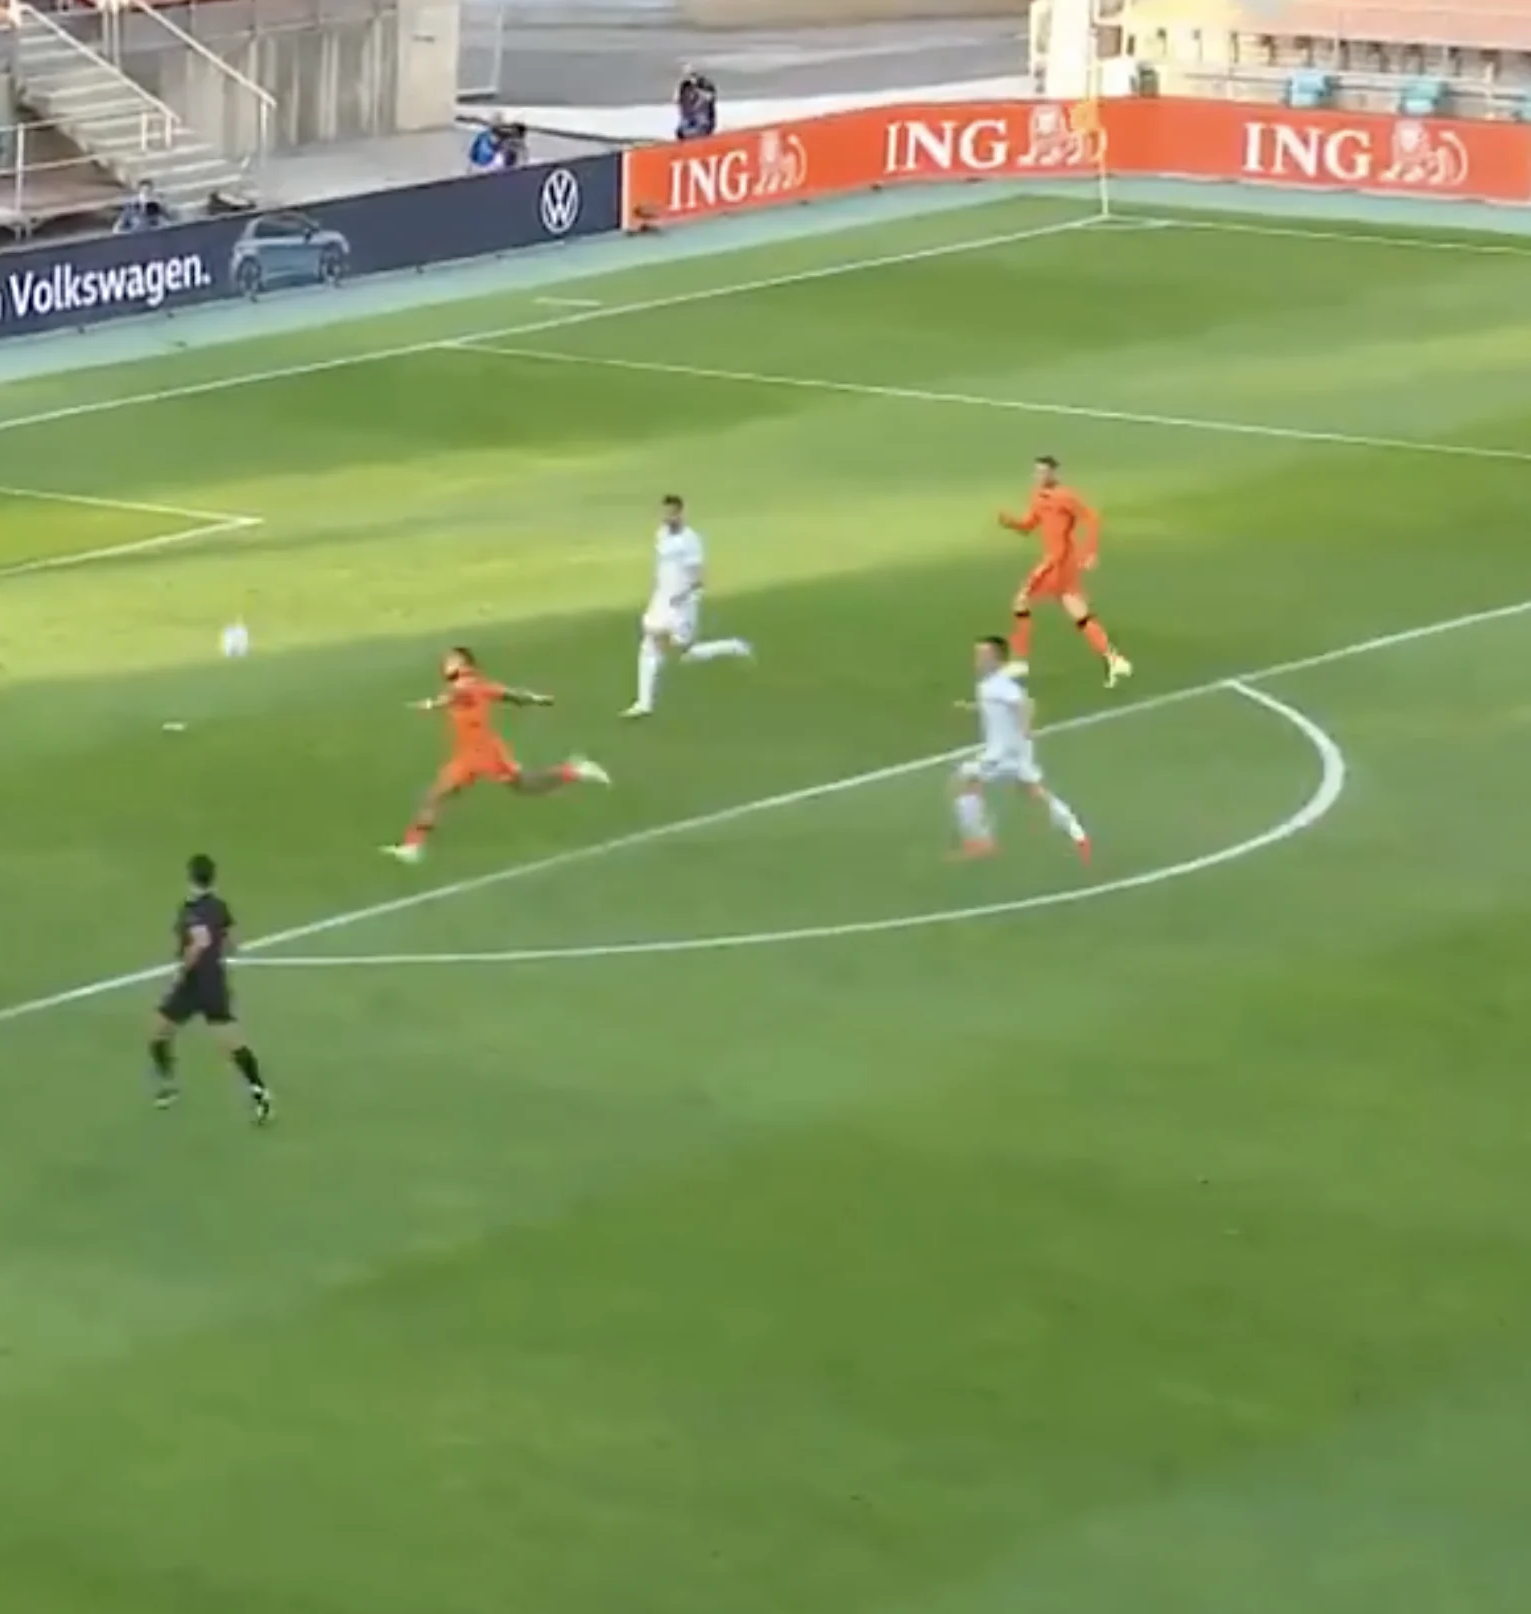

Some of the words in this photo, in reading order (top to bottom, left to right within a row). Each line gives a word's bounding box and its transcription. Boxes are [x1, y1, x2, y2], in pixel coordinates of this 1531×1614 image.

[880, 119, 1010, 174] ING
[1242, 121, 1372, 180] ING
[669, 150, 749, 211] ING
[9, 253, 211, 316] Volkswagen.
